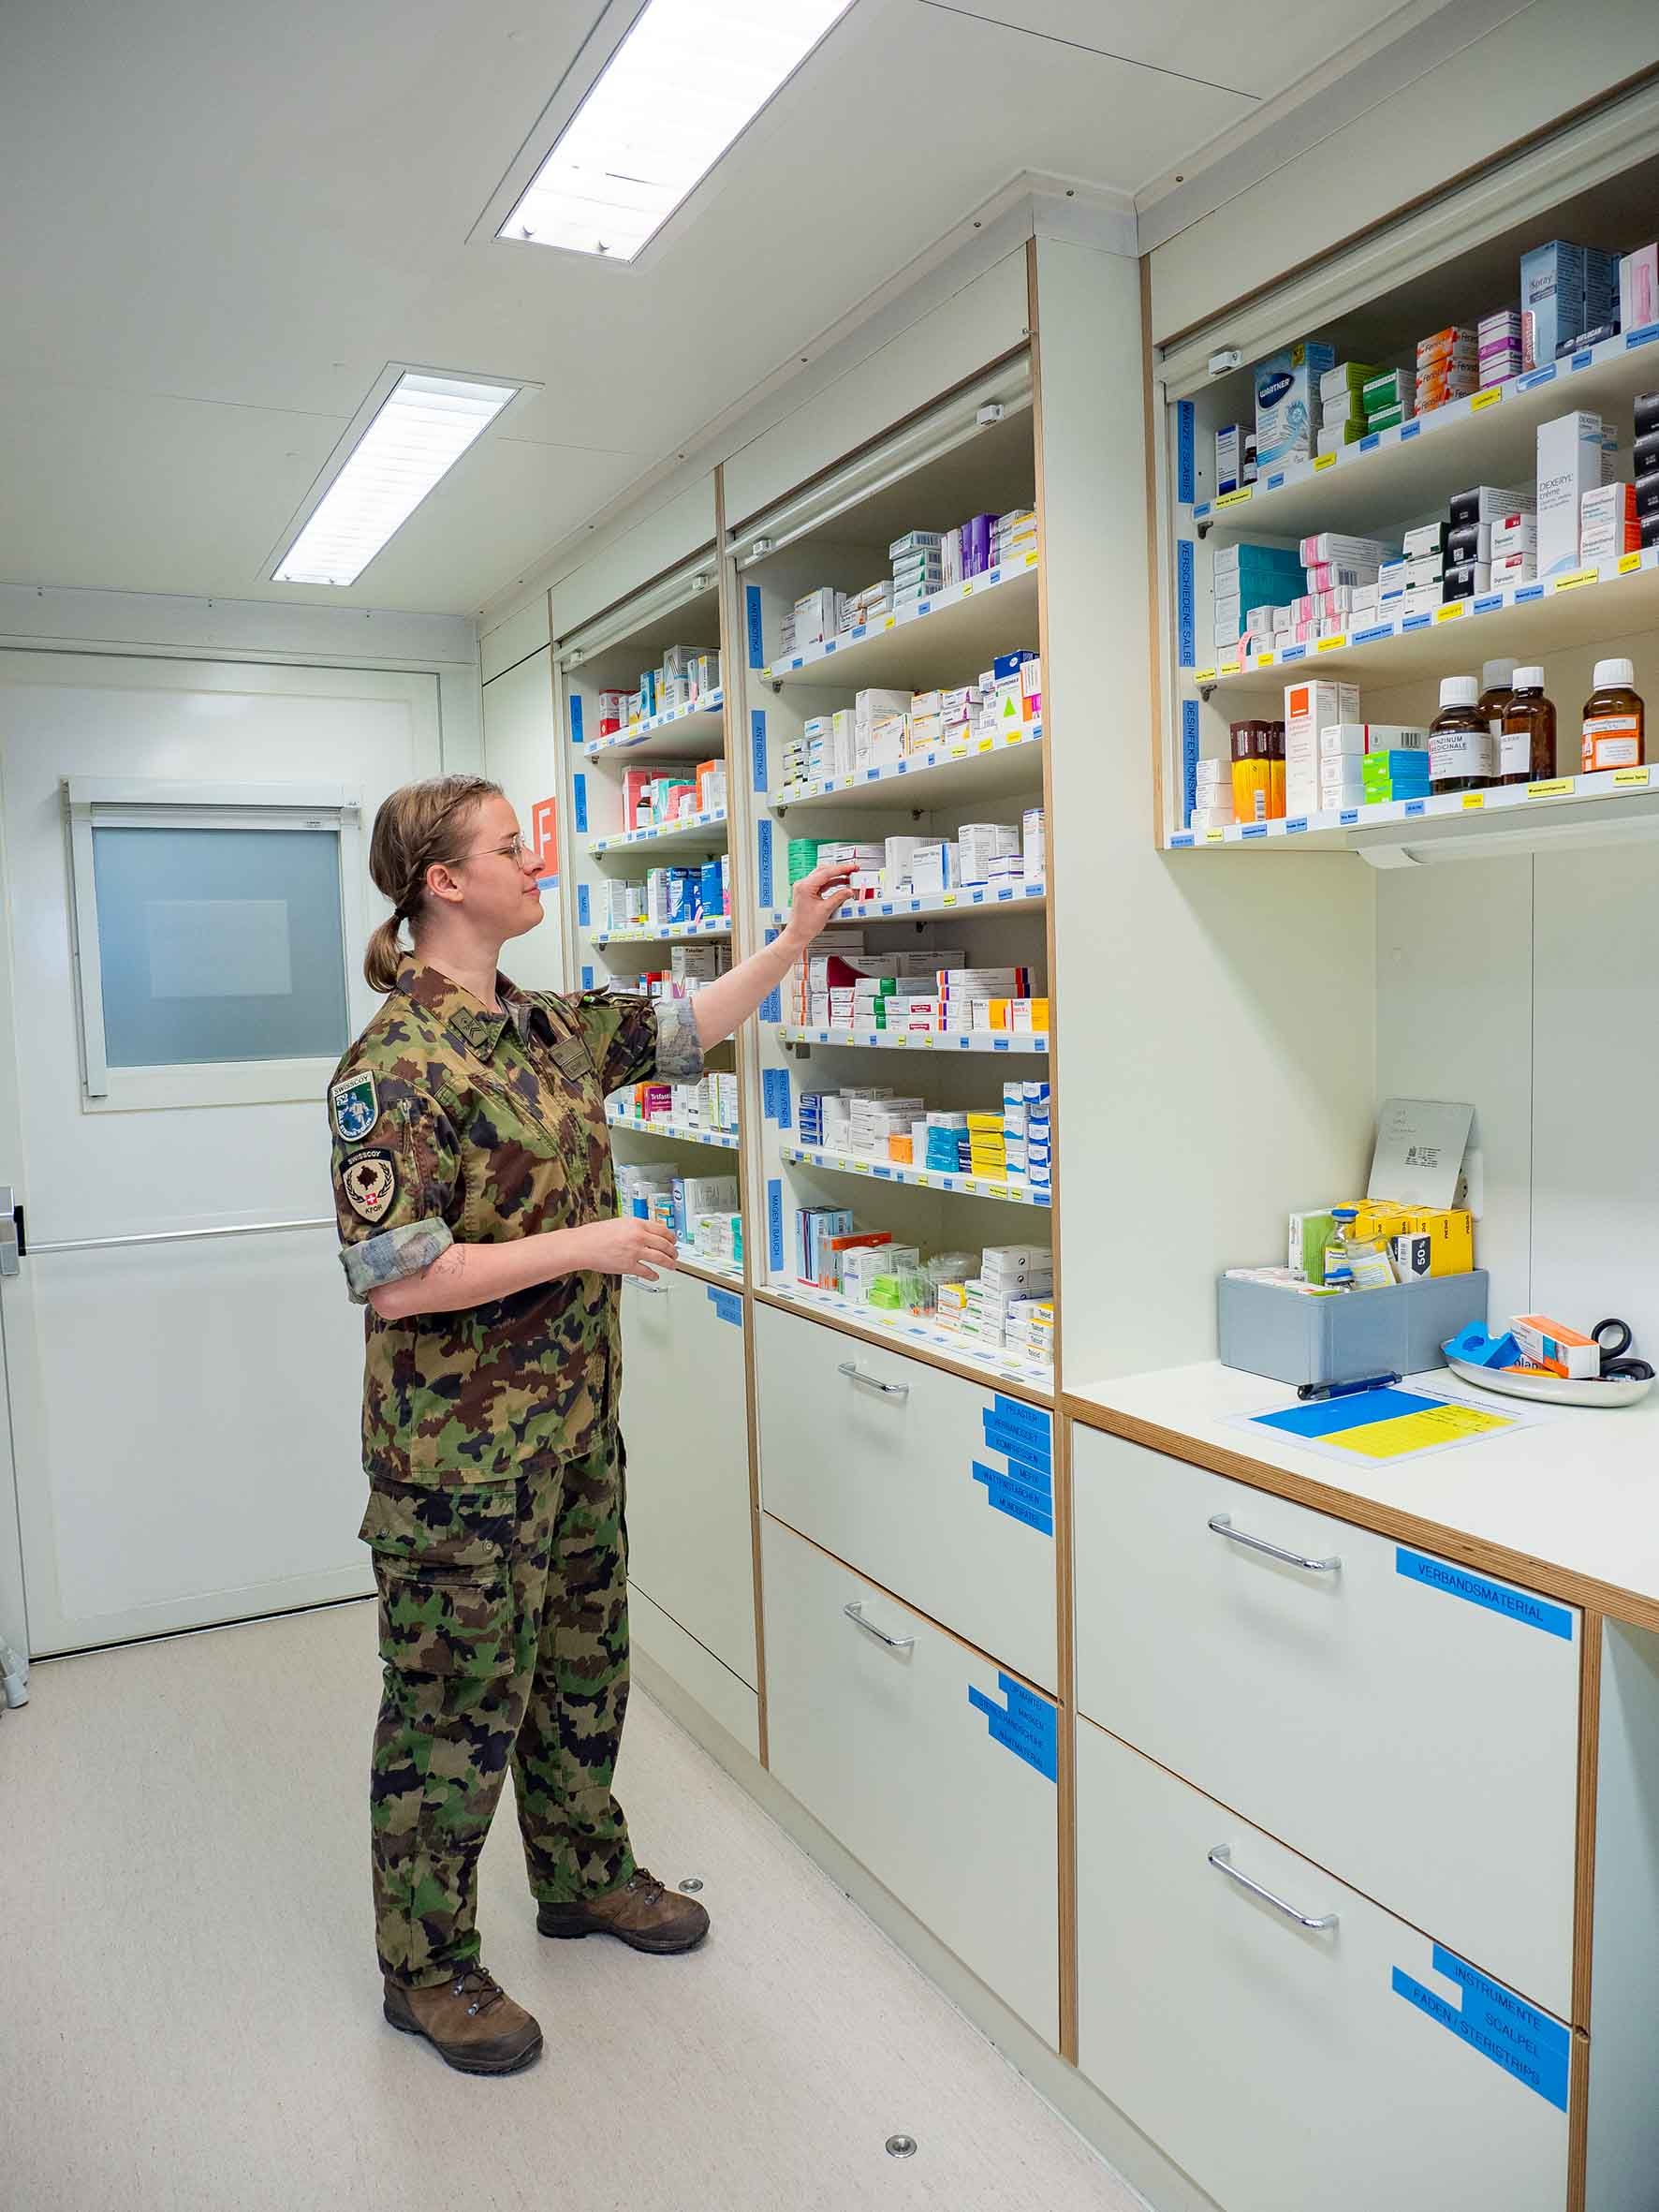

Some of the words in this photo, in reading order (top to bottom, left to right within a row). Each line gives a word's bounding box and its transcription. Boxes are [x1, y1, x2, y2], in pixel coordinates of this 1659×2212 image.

[1258, 377, 1291, 399] WARTNER
[1182, 403, 1192, 443] WARZE
[1182, 450, 1192, 500] SCABIES
[1539, 472, 1574, 492] DEXERYL
[1182, 542, 1191, 627] VERSCHIEDENE
[751, 602, 760, 652] ANTIBIOTIKA
[1182, 630, 1192, 665] SALBE
[1186, 702, 1195, 818] DESINFEKTIONSMITT
[333, 1074, 369, 1096] SWISSCOY
[347, 1150, 382, 1166] SWISSCOY
[365, 1204, 383, 1215] KFOR
[1417, 1562, 1545, 1622] VERBANDSMATERIAL
[1453, 1963, 1543, 2032] INSTRUMENTE
[1412, 1988, 1452, 2025] FADEN
[1459, 2019, 1541, 2087] STERISTRIPS
[1484, 2012, 1540, 2057] SCALPEL
